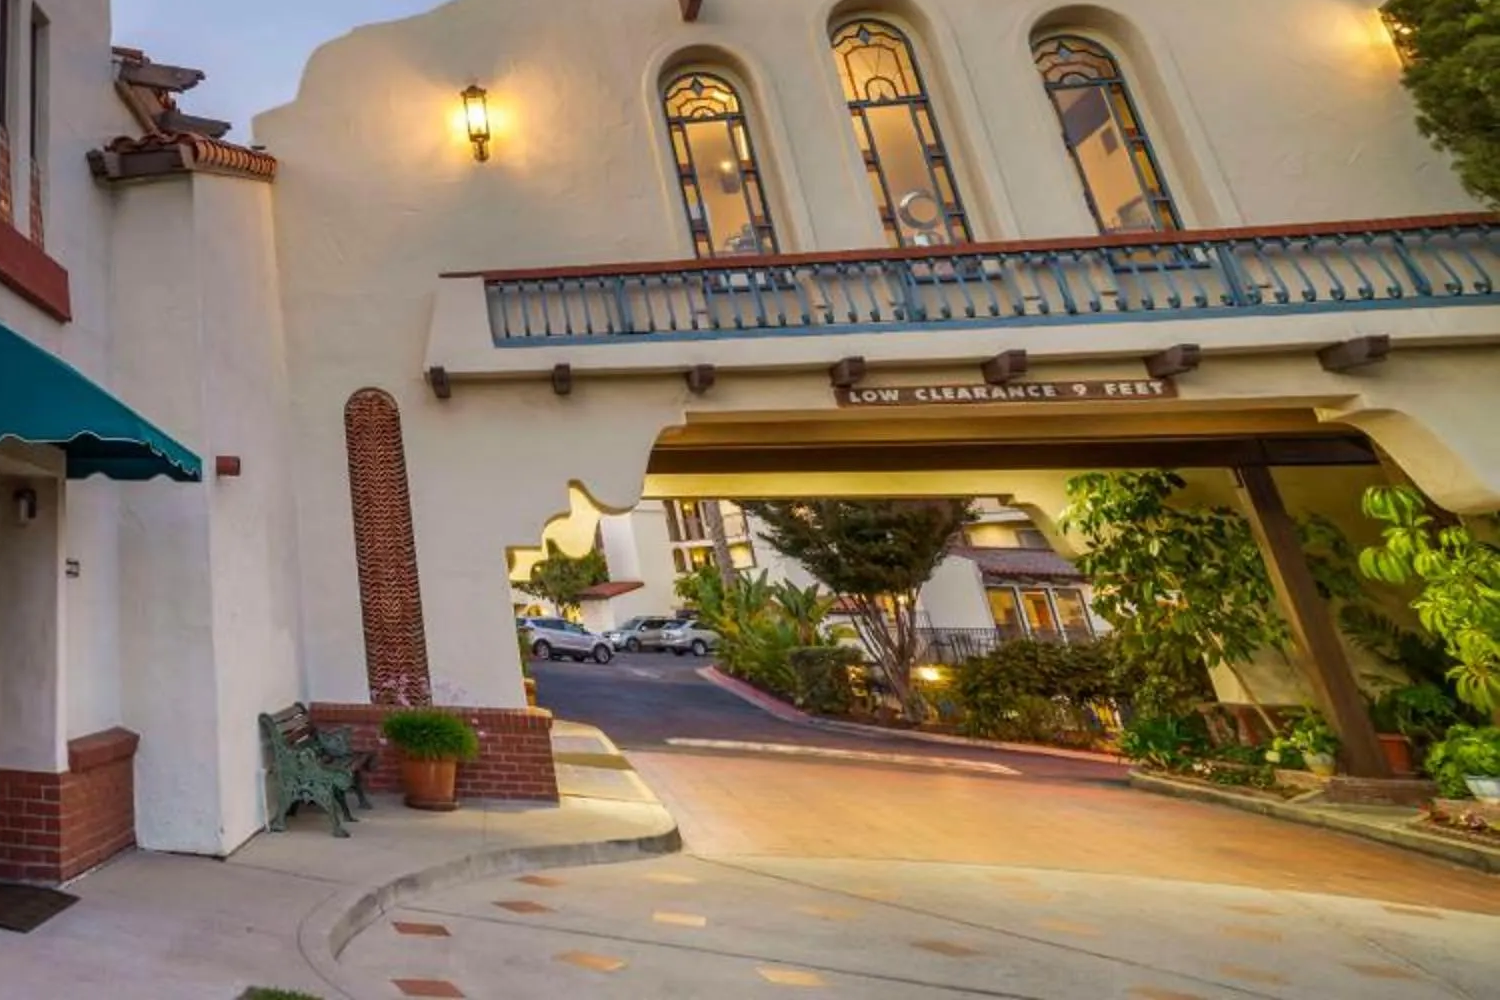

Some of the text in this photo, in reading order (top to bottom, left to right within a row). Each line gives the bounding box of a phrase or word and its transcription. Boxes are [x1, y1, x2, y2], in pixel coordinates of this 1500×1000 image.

[849, 381, 1164, 403] LOW CLEARANCE 9 FEET
